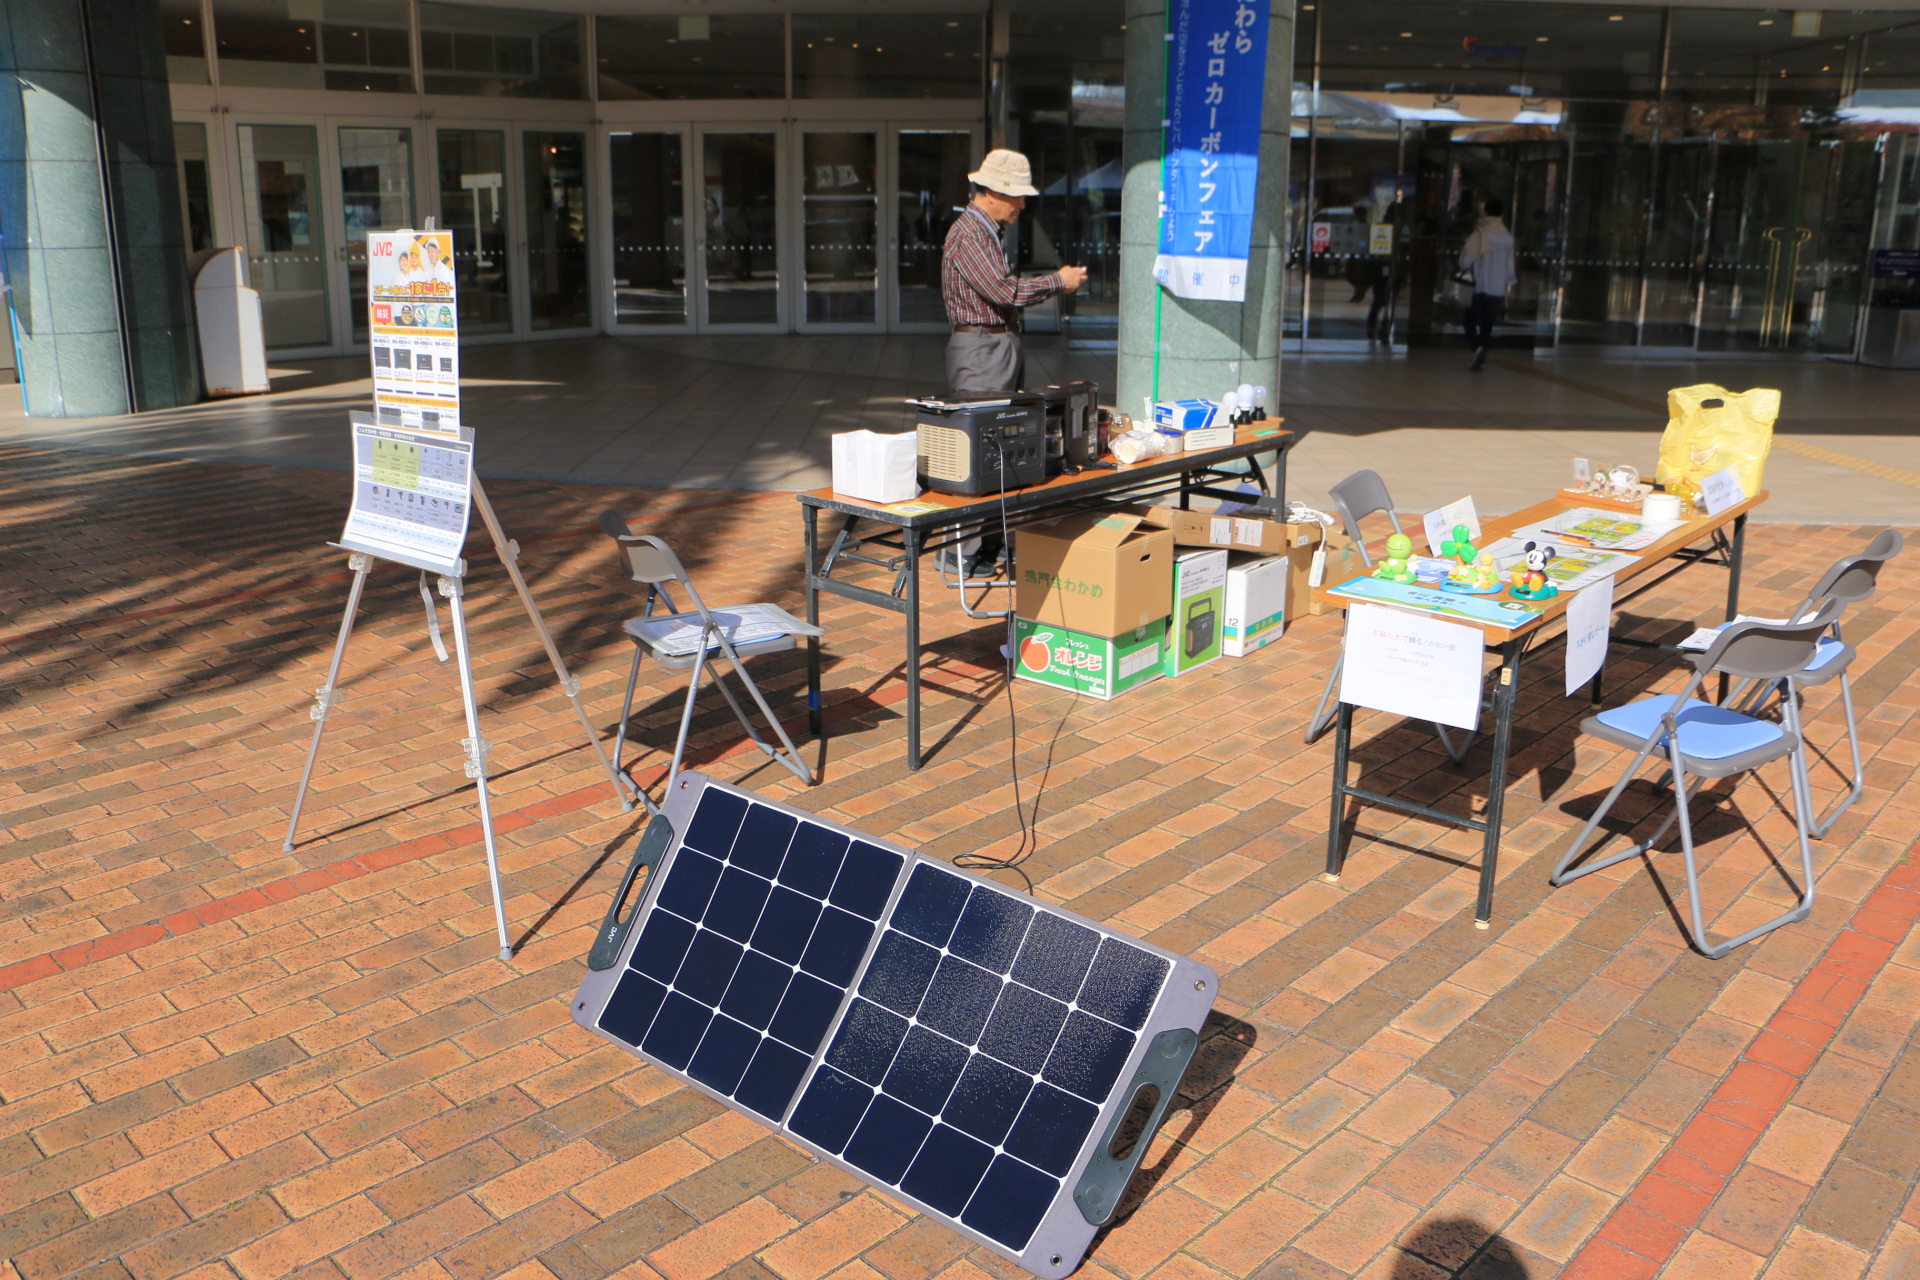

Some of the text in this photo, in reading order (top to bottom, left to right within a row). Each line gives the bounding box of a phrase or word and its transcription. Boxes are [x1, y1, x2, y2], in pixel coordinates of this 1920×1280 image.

[1235, 0, 1257, 54] わら
[1194, 31, 1231, 252] ゼロカーボンフェア
[372, 241, 393, 257] JVC
[1157, 268, 1240, 287] 開催中
[376, 308, 389, 320] 防災
[996, 412, 1006, 420] JVC
[1025, 569, 1103, 598] 鳴門生わかめ
[1228, 618, 1239, 627] 12
[1065, 638, 1090, 649] フレッシュ
[1054, 646, 1102, 671] オレンジ
[1048, 664, 1106, 687] Fresh Oranges
[607, 926, 618, 944] JVC
